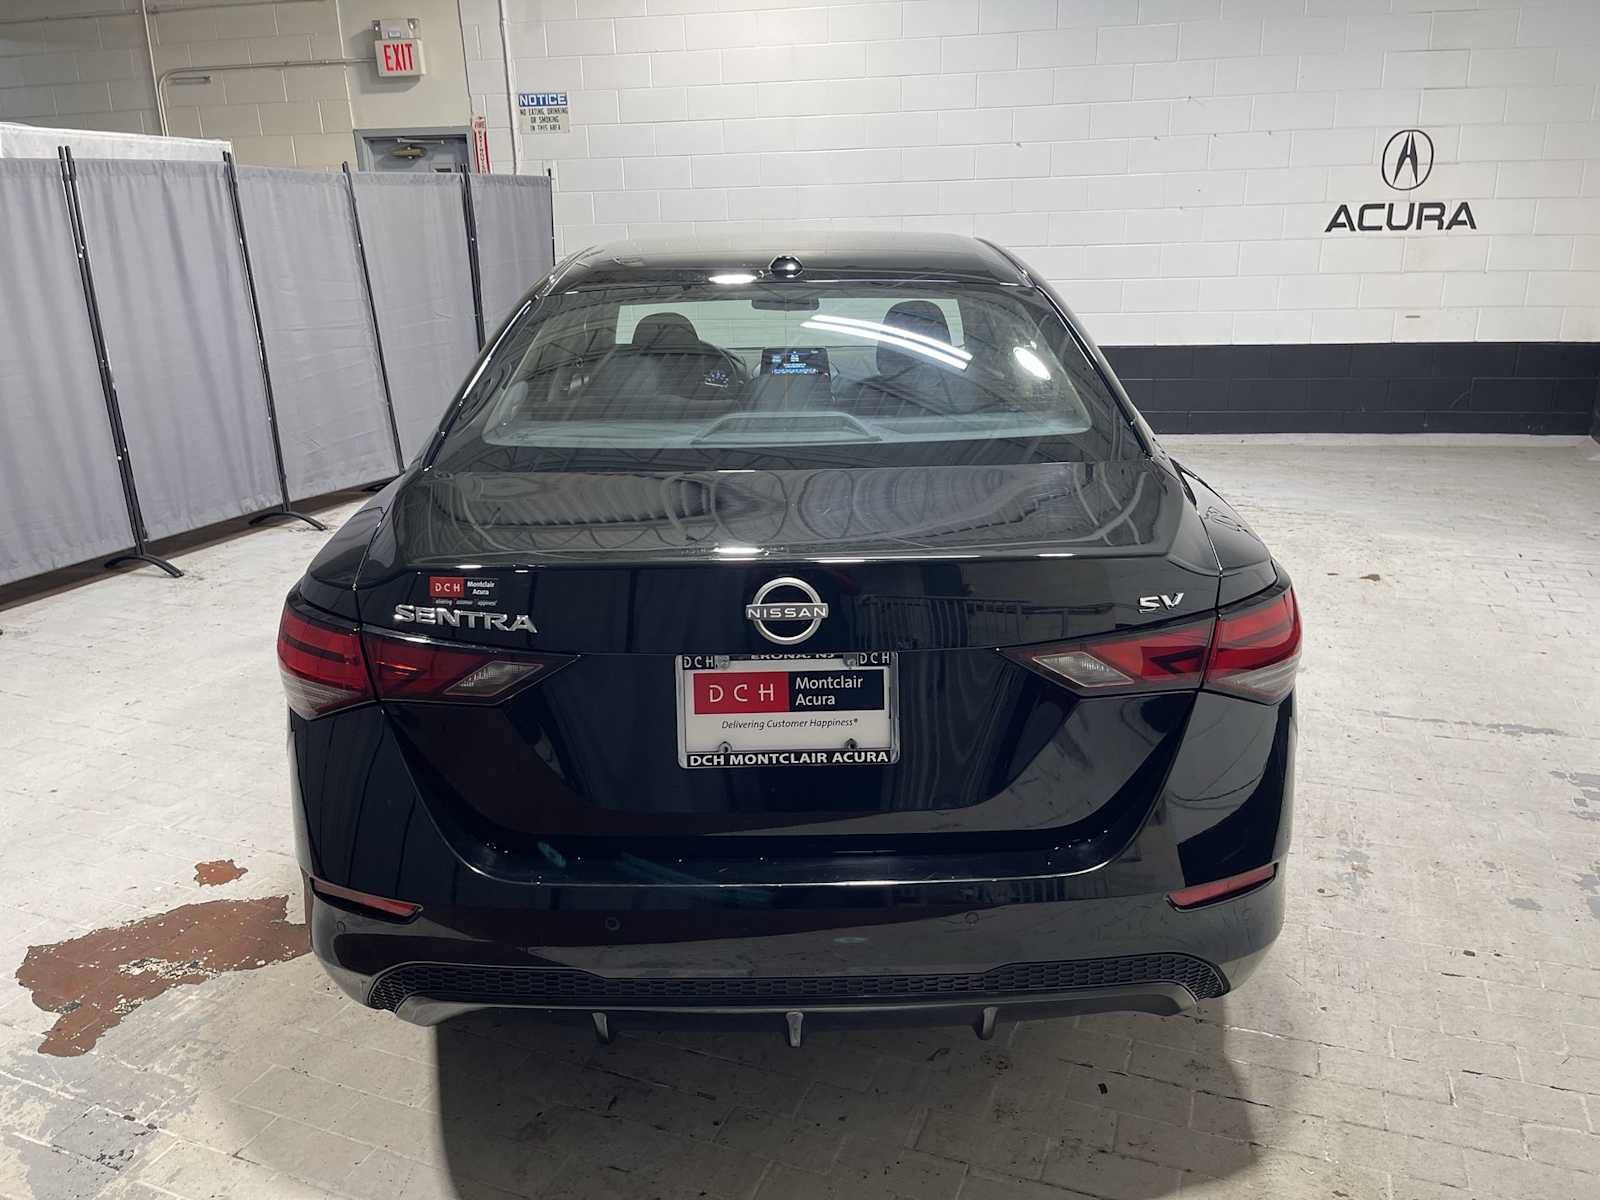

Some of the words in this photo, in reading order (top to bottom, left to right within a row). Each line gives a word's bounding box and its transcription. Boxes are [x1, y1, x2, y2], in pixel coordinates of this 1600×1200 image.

[383, 43, 413, 72] EXIT
[519, 94, 567, 106] NOTICE
[1325, 201, 1477, 233] ACURA
[1138, 592, 1185, 614] SV
[393, 604, 538, 634] SENTRA
[747, 607, 827, 618] NISSAN
[795, 675, 864, 690] Montclair
[795, 694, 836, 707] Acura
[721, 720, 765, 731] Delivering
[766, 719, 808, 730] Customer
[689, 754, 726, 767] DCH
[729, 752, 828, 766] MONTCLAIR
[831, 751, 889, 764] ACURA
